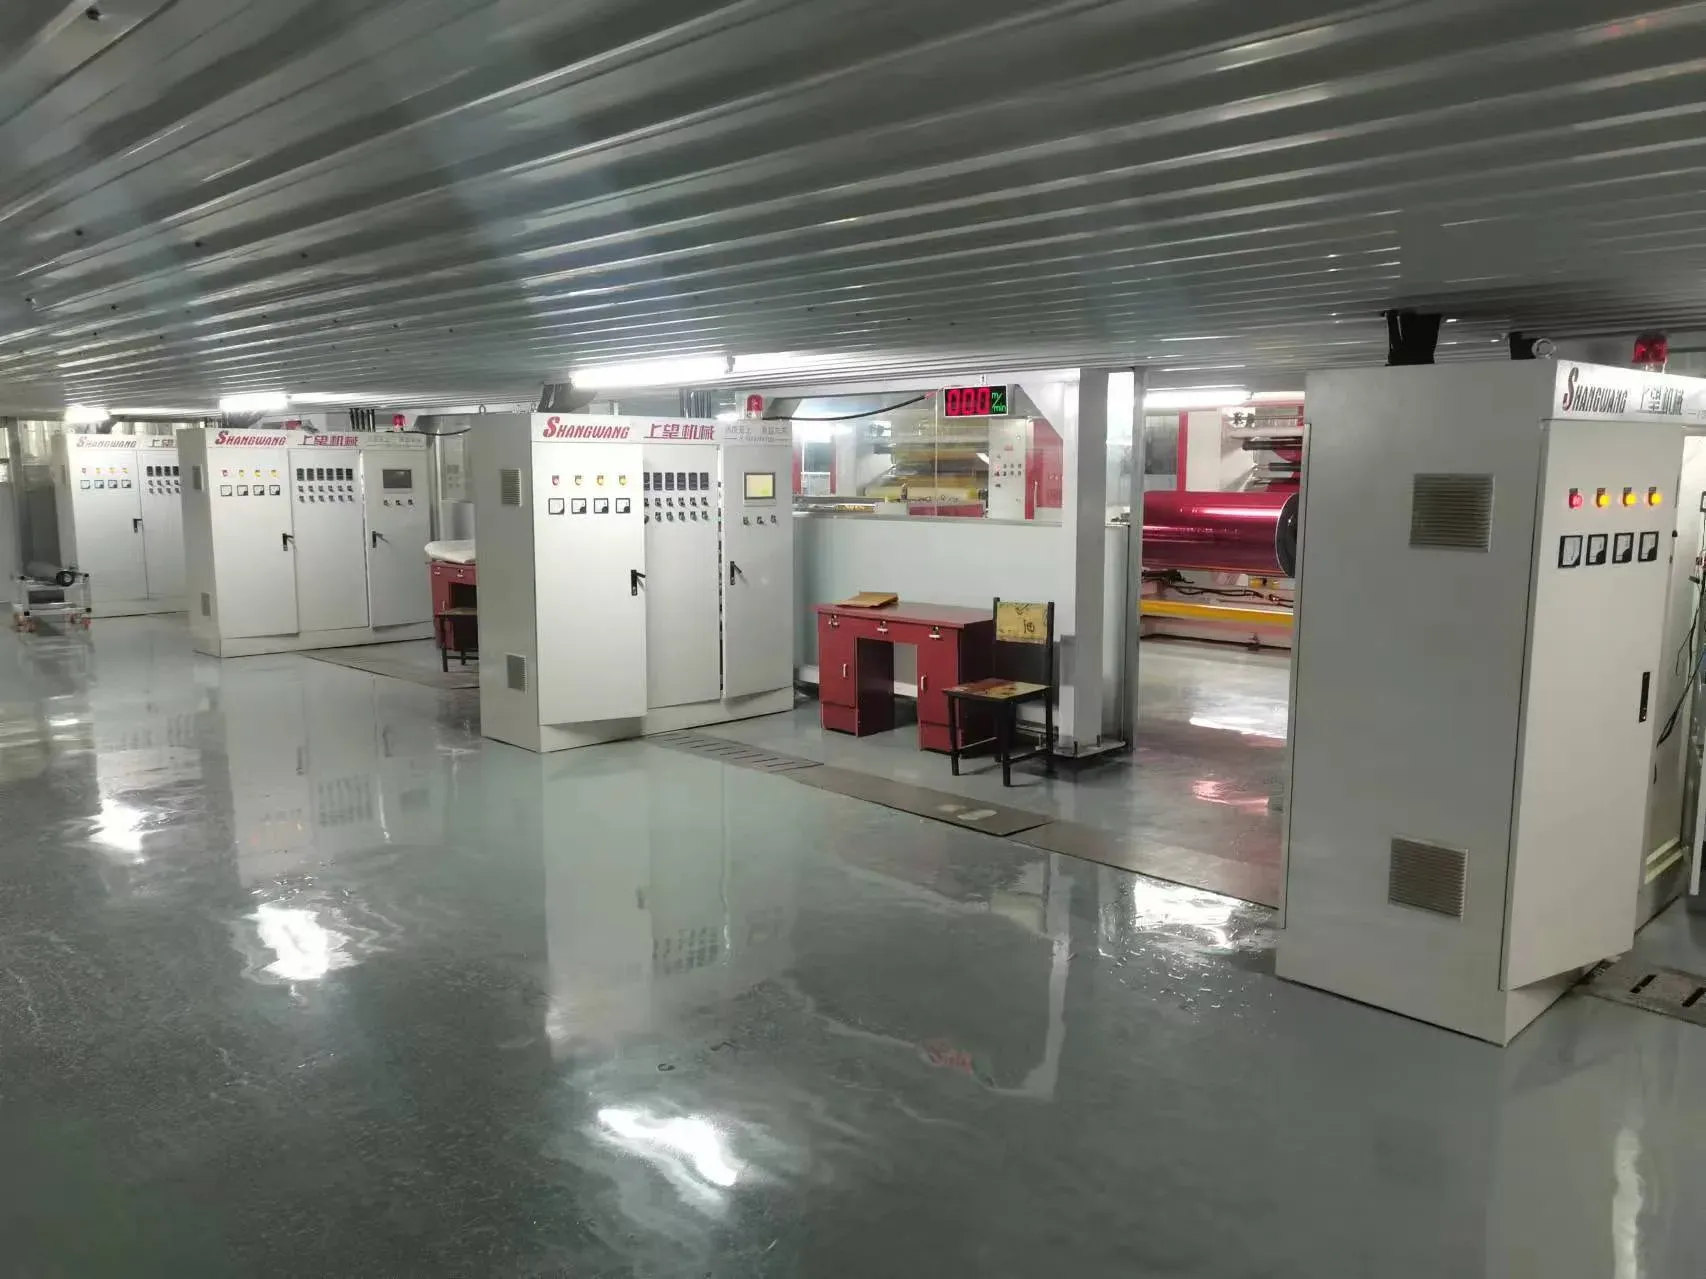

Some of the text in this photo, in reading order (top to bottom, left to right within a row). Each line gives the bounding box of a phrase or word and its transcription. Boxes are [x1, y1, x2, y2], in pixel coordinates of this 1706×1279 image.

[1562, 367, 1628, 413] SHANGWANG
[947, 388, 991, 416] 000
[543, 416, 630, 439] SHANGWANG
[643, 423, 715, 441] 上望机械
[76, 436, 137, 448] SHANGWANG
[147, 439, 177, 448] 上望
[215, 430, 287, 446] SHANGWANG
